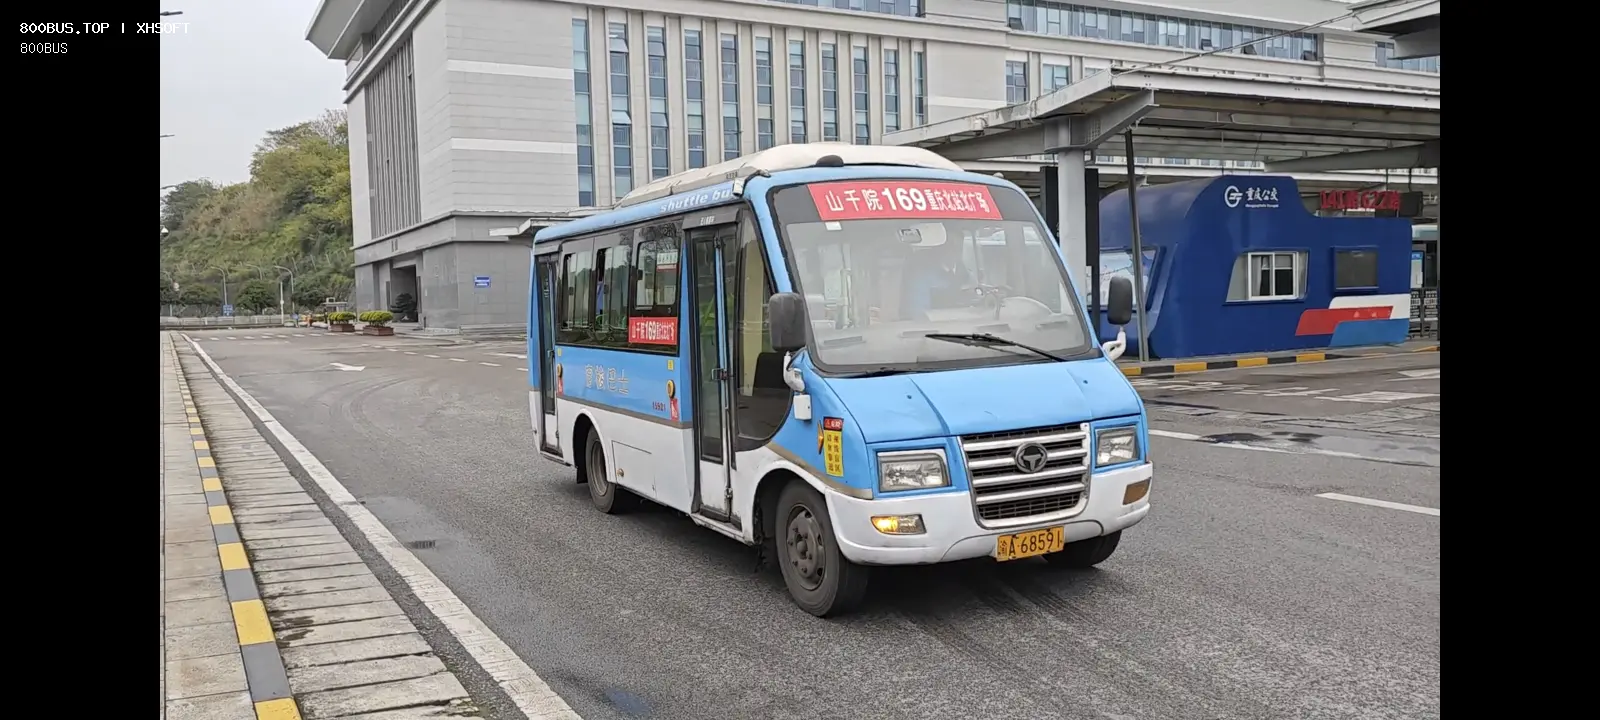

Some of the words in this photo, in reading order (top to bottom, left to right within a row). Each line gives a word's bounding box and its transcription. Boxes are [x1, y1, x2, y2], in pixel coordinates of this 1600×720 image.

[660, 193, 708, 213] shuttle
[712, 188, 733, 201] bu
[1245, 187, 1279, 202] 重庆公交
